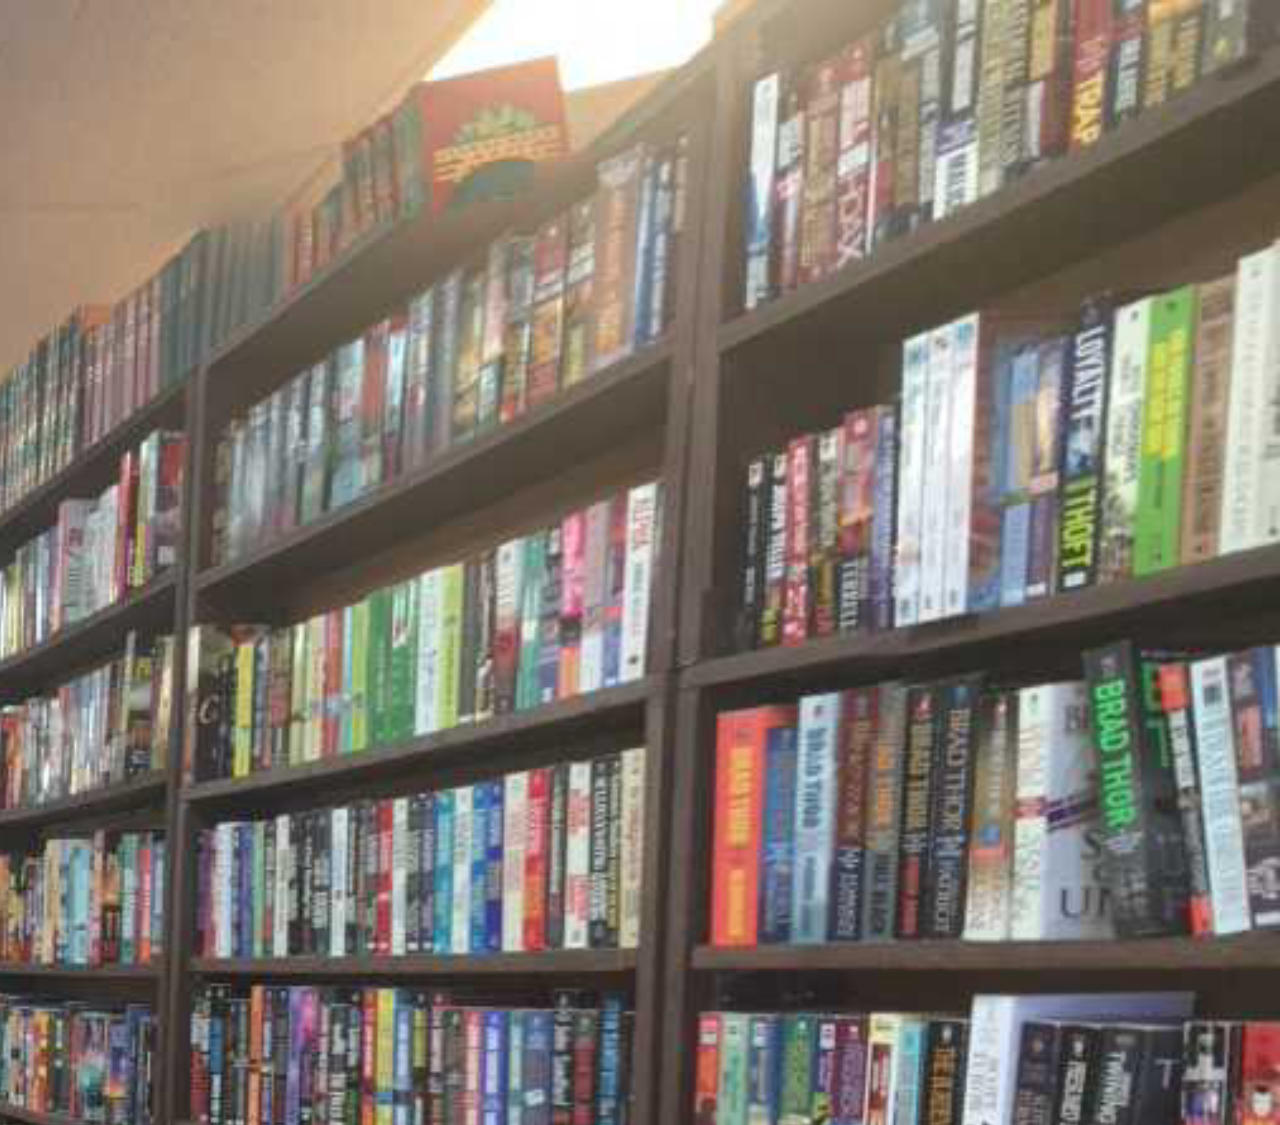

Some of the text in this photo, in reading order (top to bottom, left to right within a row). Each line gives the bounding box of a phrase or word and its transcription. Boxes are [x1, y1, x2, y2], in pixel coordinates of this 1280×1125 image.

[1074, 326, 1106, 434] LOYALTY
[1094, 678, 1130, 753] BRAD
[942, 708, 972, 832] BRAD THOR
[1103, 755, 1137, 831] THOR
[1097, 1050, 1127, 1125] TWINING
